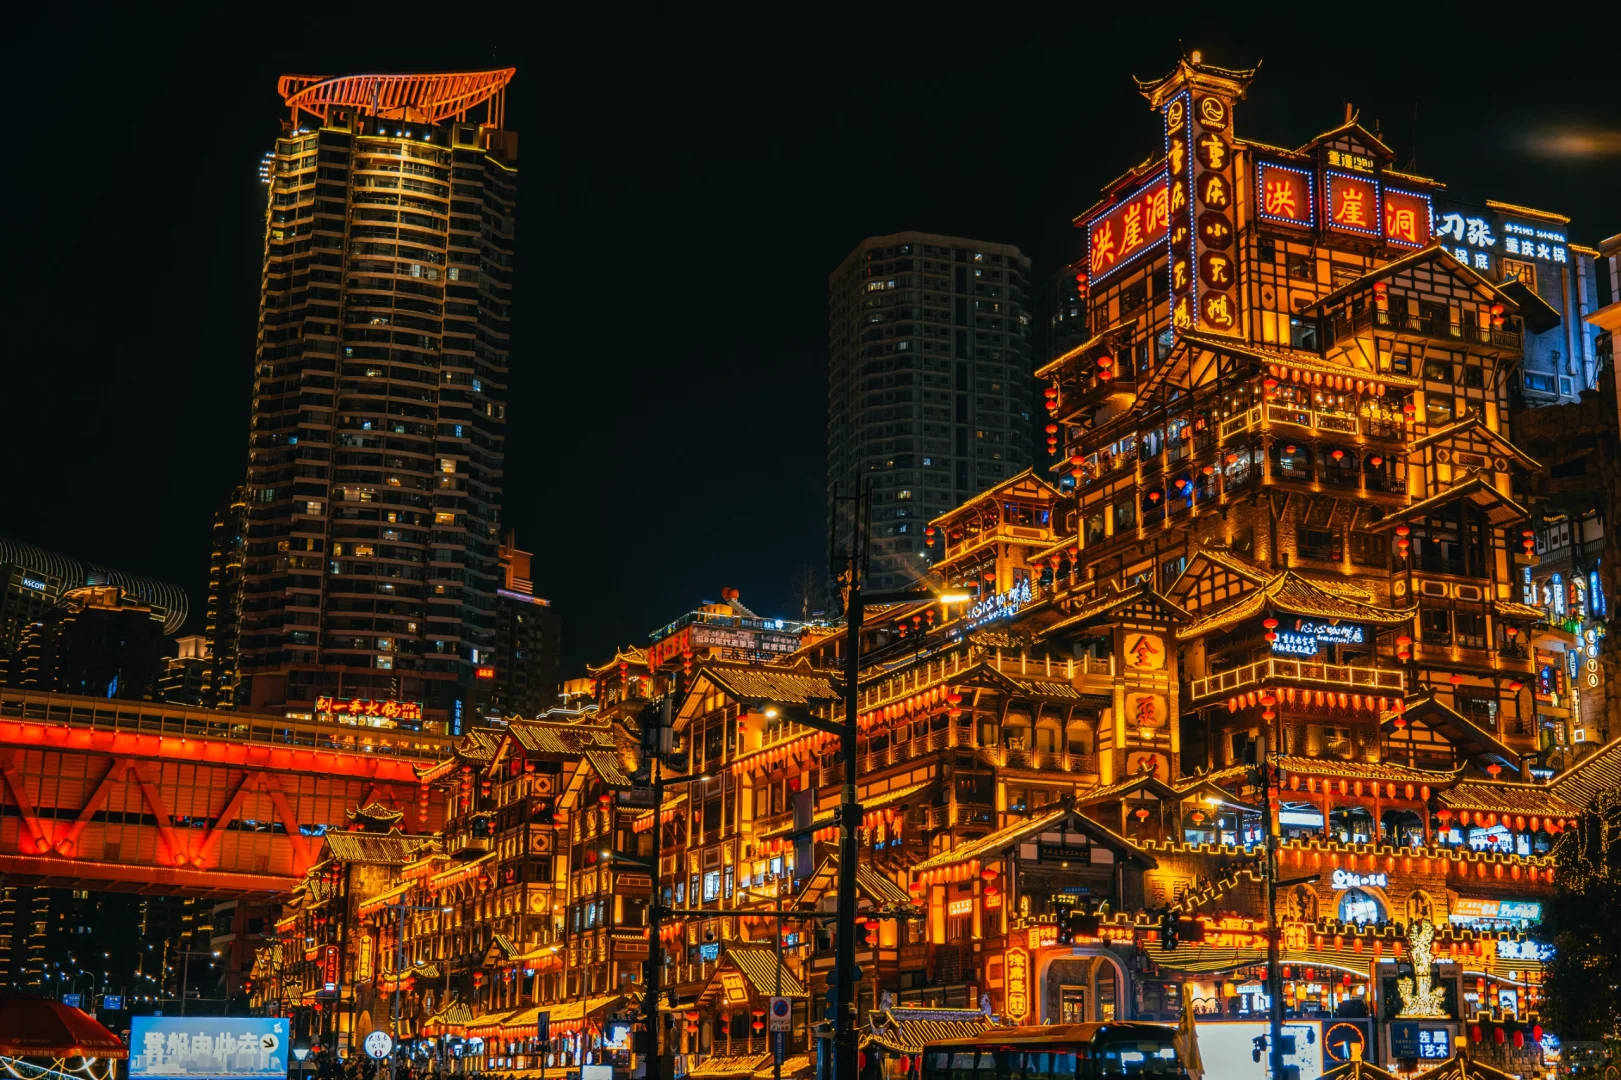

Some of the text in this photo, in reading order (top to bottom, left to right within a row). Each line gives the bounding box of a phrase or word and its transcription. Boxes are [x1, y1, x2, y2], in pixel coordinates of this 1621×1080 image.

[1266, 181, 1415, 242] 洪崖洞
[1091, 187, 1169, 272] 洪崖洞
[1441, 245, 1489, 270] 锅底
[1506, 237, 1566, 263] 重庆火锅
[23, 579, 46, 591] ASCOTT
